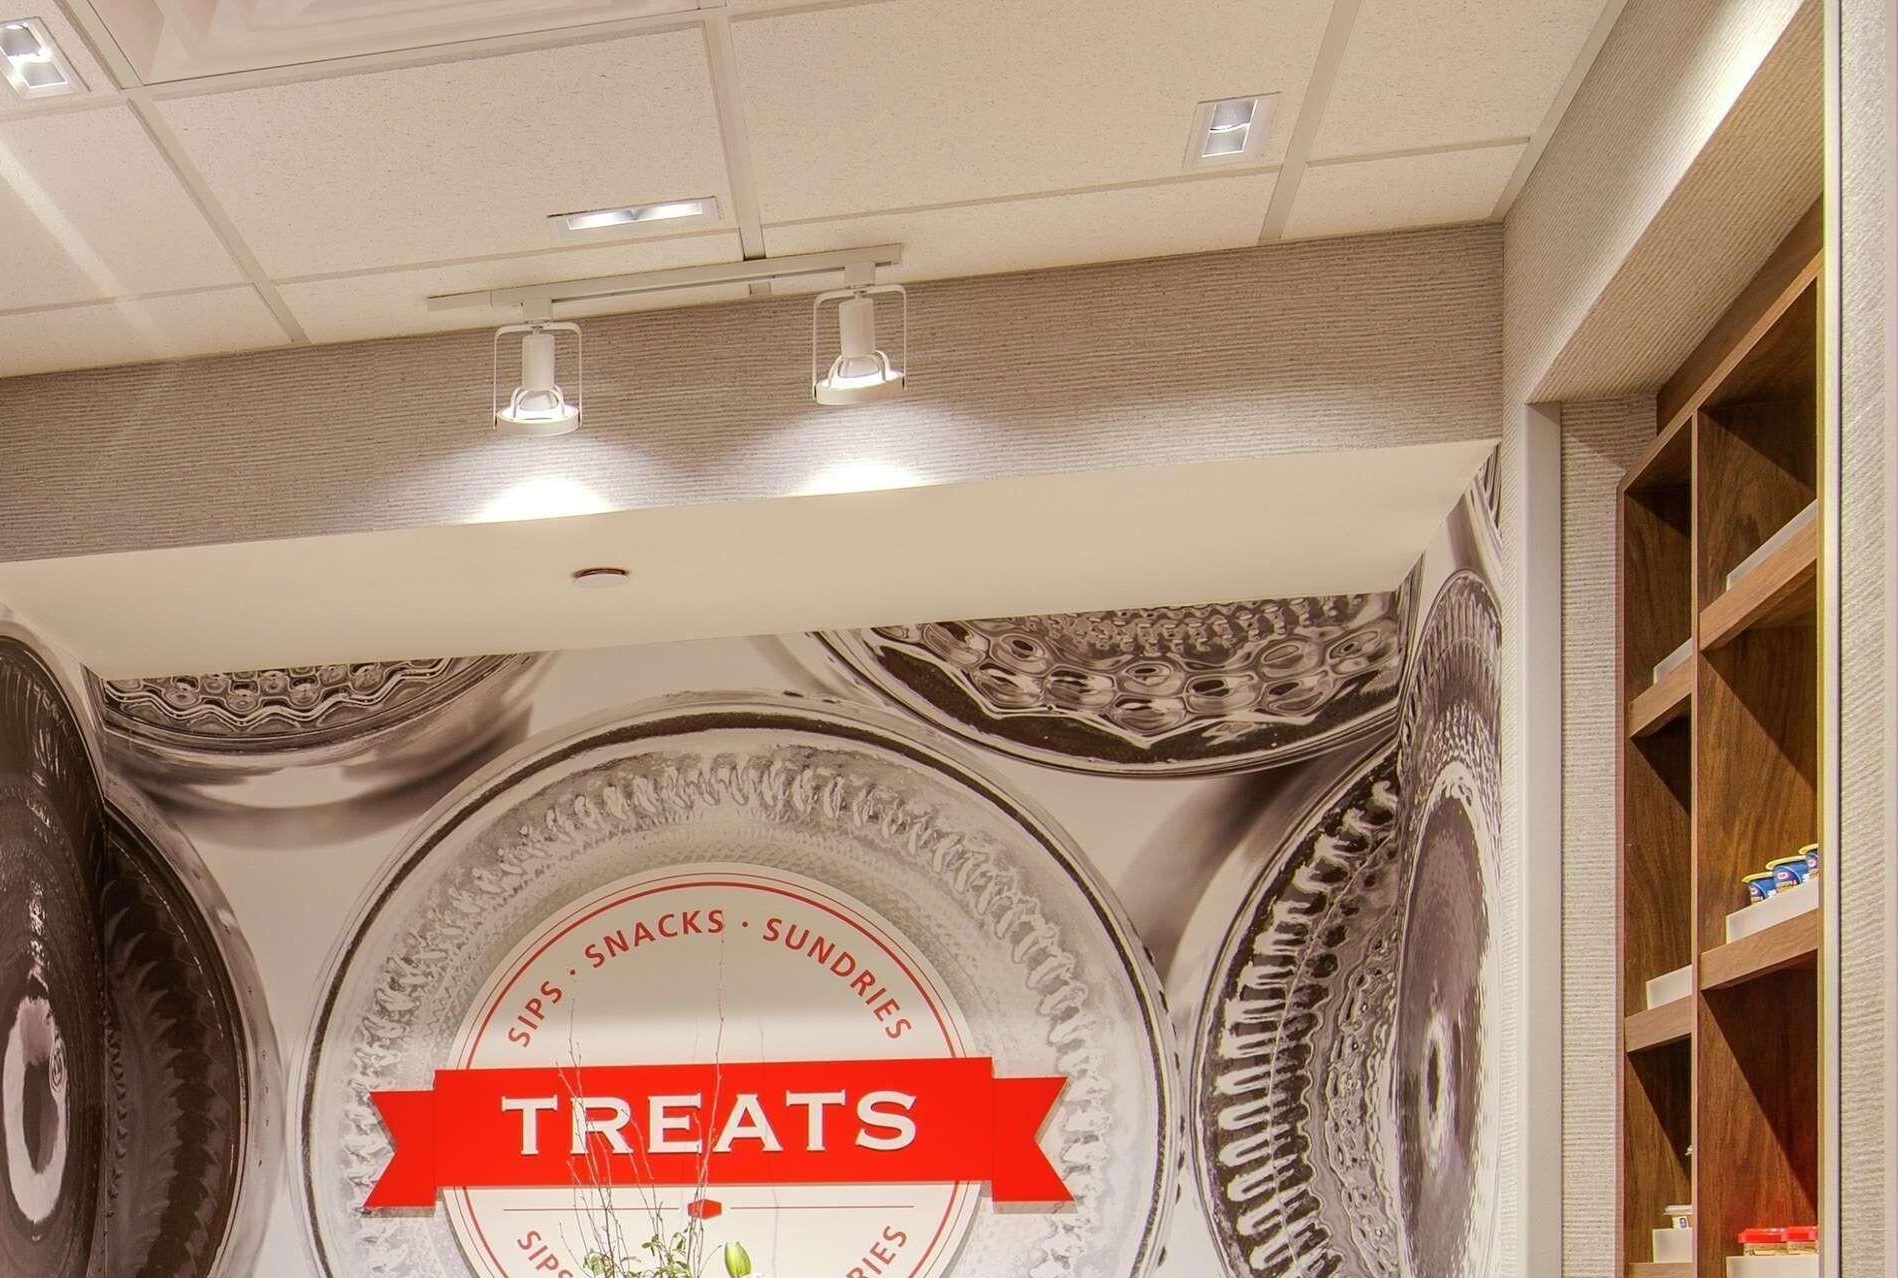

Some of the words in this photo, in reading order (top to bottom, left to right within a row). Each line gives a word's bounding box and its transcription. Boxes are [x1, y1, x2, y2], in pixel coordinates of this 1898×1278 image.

[507, 978, 563, 1048] SIPS
[583, 908, 725, 970] SNACKS
[762, 916, 914, 1042] SUNDRIES
[501, 1088, 918, 1157] TREATS
